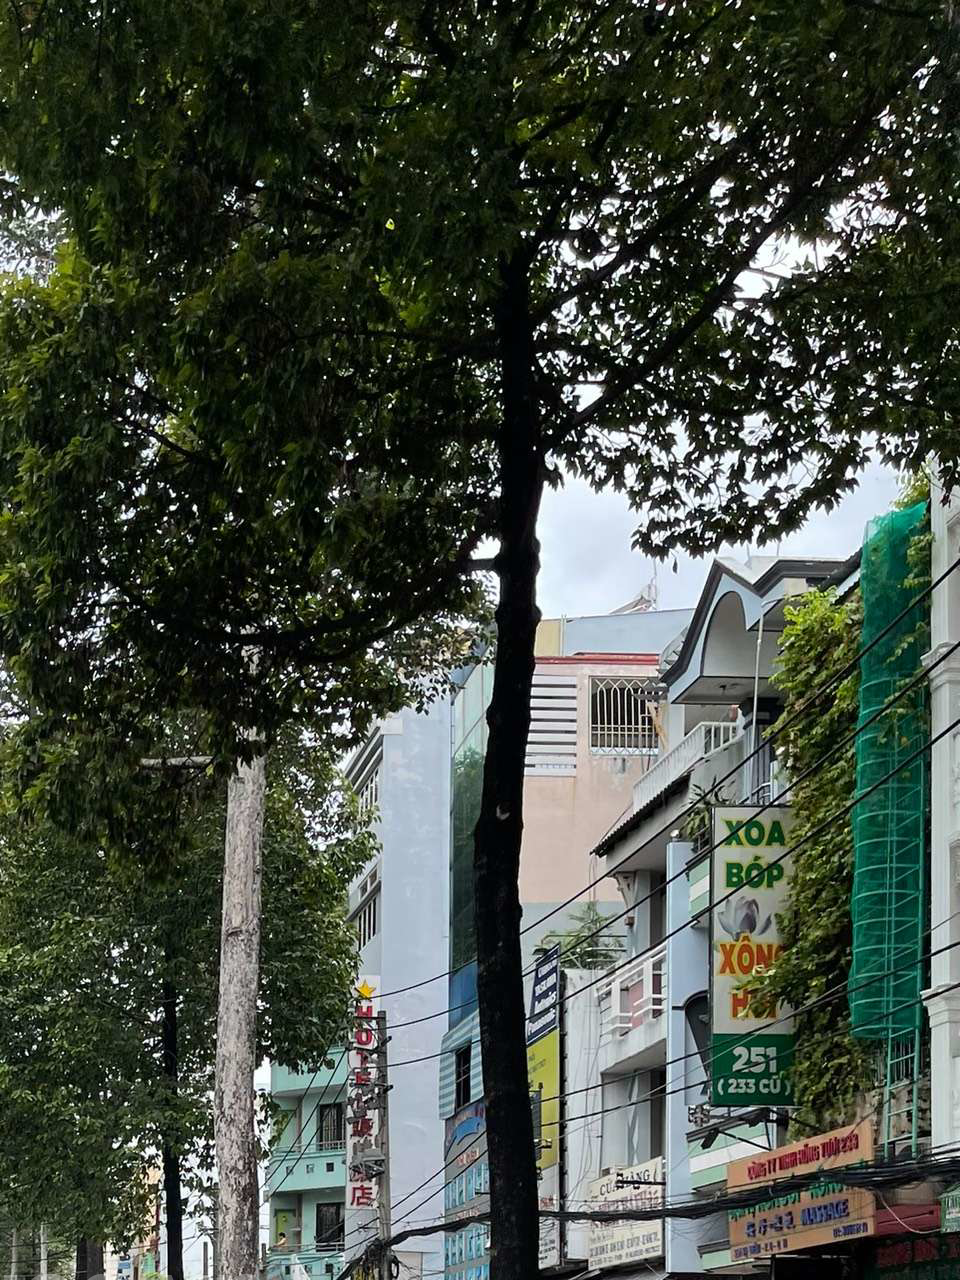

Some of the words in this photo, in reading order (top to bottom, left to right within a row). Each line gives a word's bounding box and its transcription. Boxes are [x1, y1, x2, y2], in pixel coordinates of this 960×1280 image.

[724, 819, 786, 847] XOA
[725, 855, 785, 889] BÓP
[732, 1046, 778, 1073] 251
